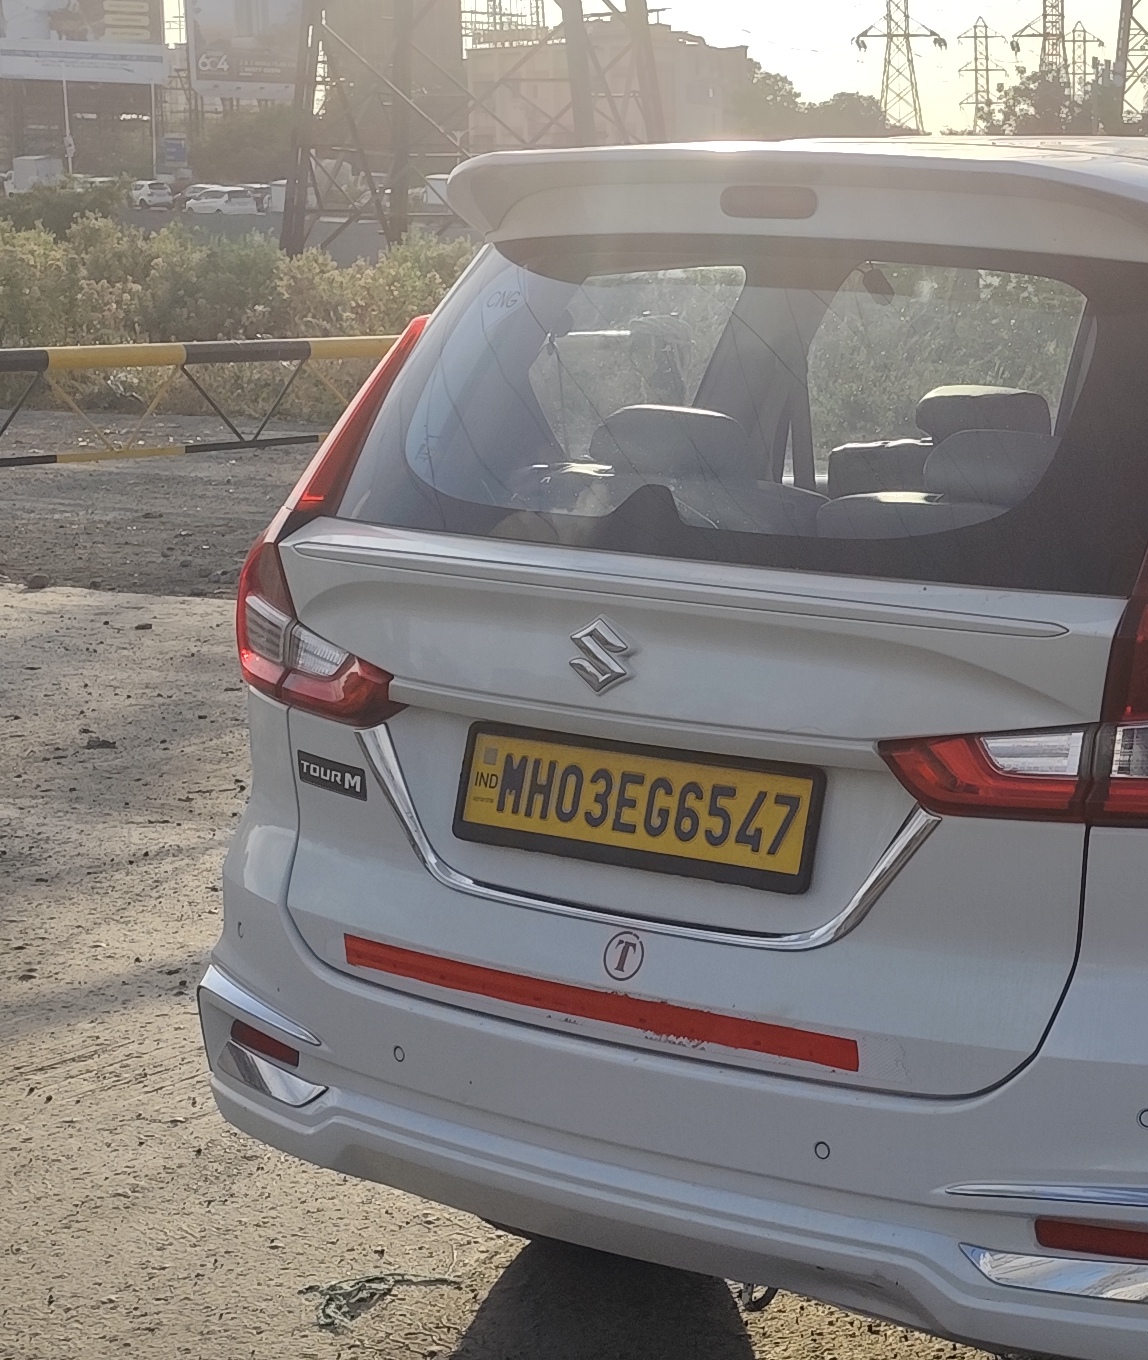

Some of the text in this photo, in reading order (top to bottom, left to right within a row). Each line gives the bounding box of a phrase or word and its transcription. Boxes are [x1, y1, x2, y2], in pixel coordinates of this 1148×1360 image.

[487, 290, 521, 308] CNG
[474, 771, 499, 789] IND
[495, 752, 802, 856] MH03EG6547
[614, 938, 637, 973] T
